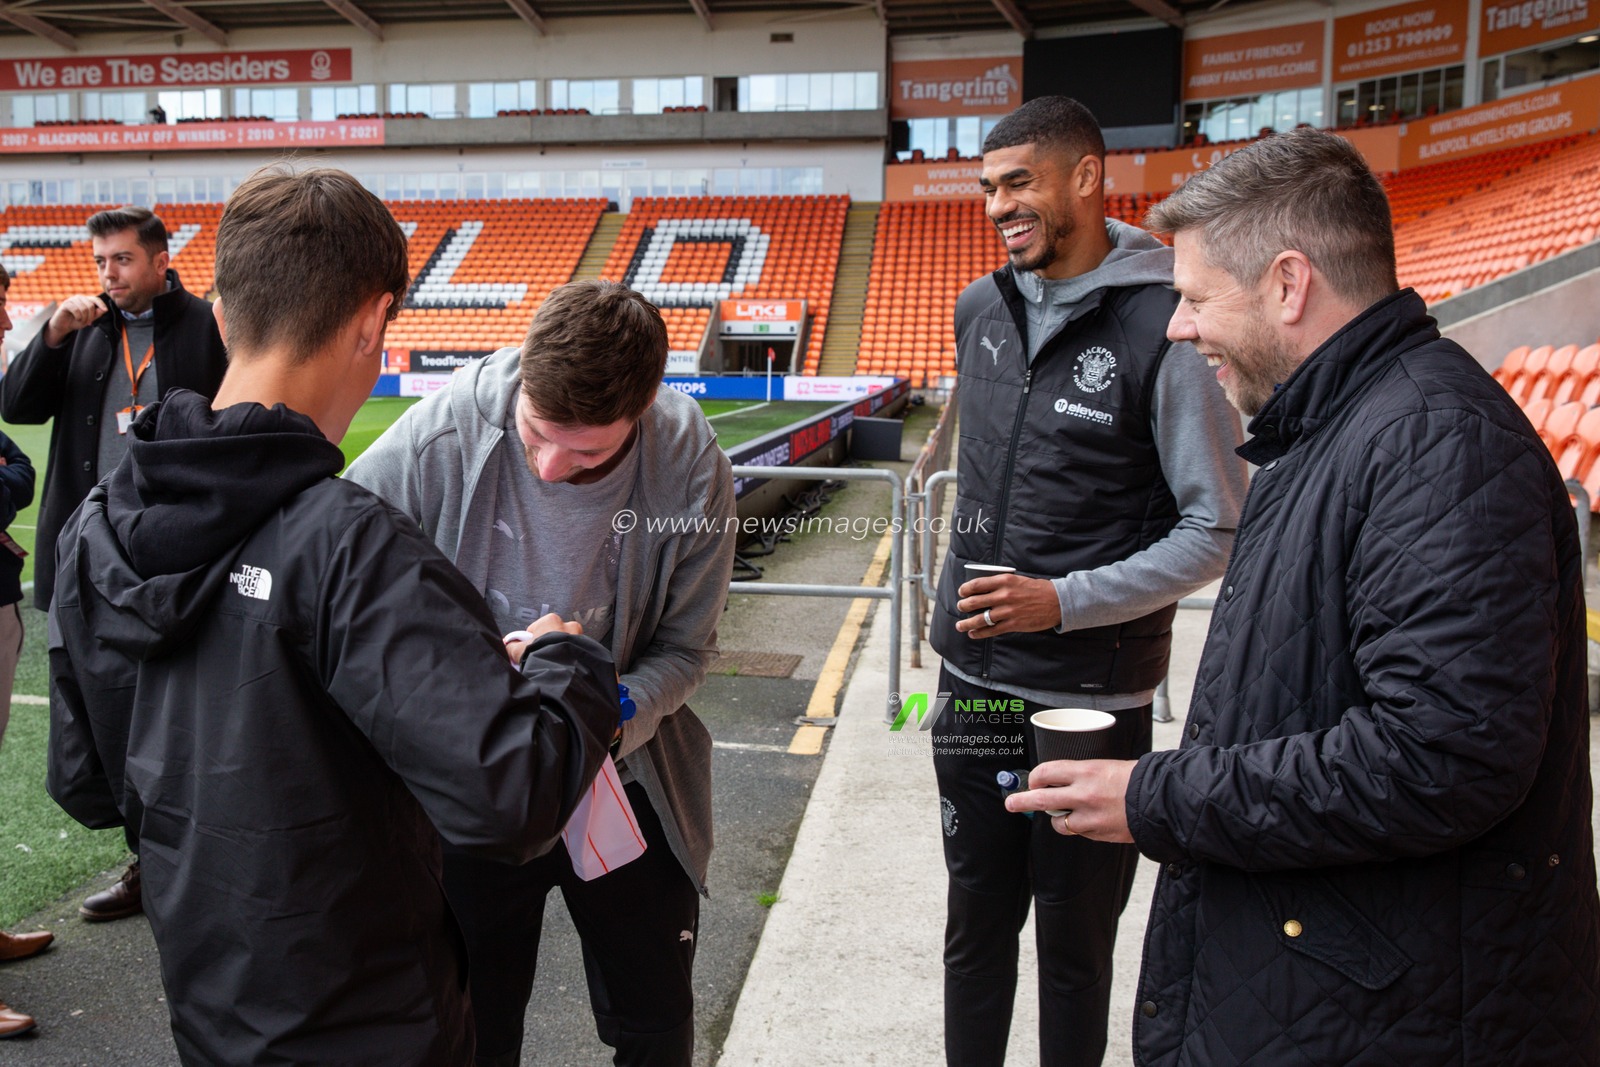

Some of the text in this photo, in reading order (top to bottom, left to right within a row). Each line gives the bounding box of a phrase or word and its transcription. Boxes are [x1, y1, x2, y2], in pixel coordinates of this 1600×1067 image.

[1365, 9, 1436, 36] BOOK NOW
[1202, 42, 1305, 66] FAMILY FRIENDLY
[1347, 36, 1392, 58] 01253
[14, 55, 290, 87] We are The Seasiders
[1189, 60, 1318, 88] AWAY FANS WELCOME
[900, 76, 1008, 102] Tangerine
[38, 133, 100, 145] BLACKPOOL
[124, 131, 149, 144] PLAY
[153, 131, 173, 143] OFF
[176, 129, 226, 142] WINNERS
[247, 128, 275, 140] 2010
[299, 127, 326, 139] 2017
[350, 126, 378, 138] 2021
[1419, 111, 1573, 159] BLACKPOOL HOTELS FOR GROUPS
[1077, 346, 1117, 369] BLACKPOOL
[1073, 374, 1112, 393] FOOTBALL CLUB
[1068, 403, 1113, 422] eleven
[230, 572, 258, 588] NORTH
[242, 564, 262, 578] THE
